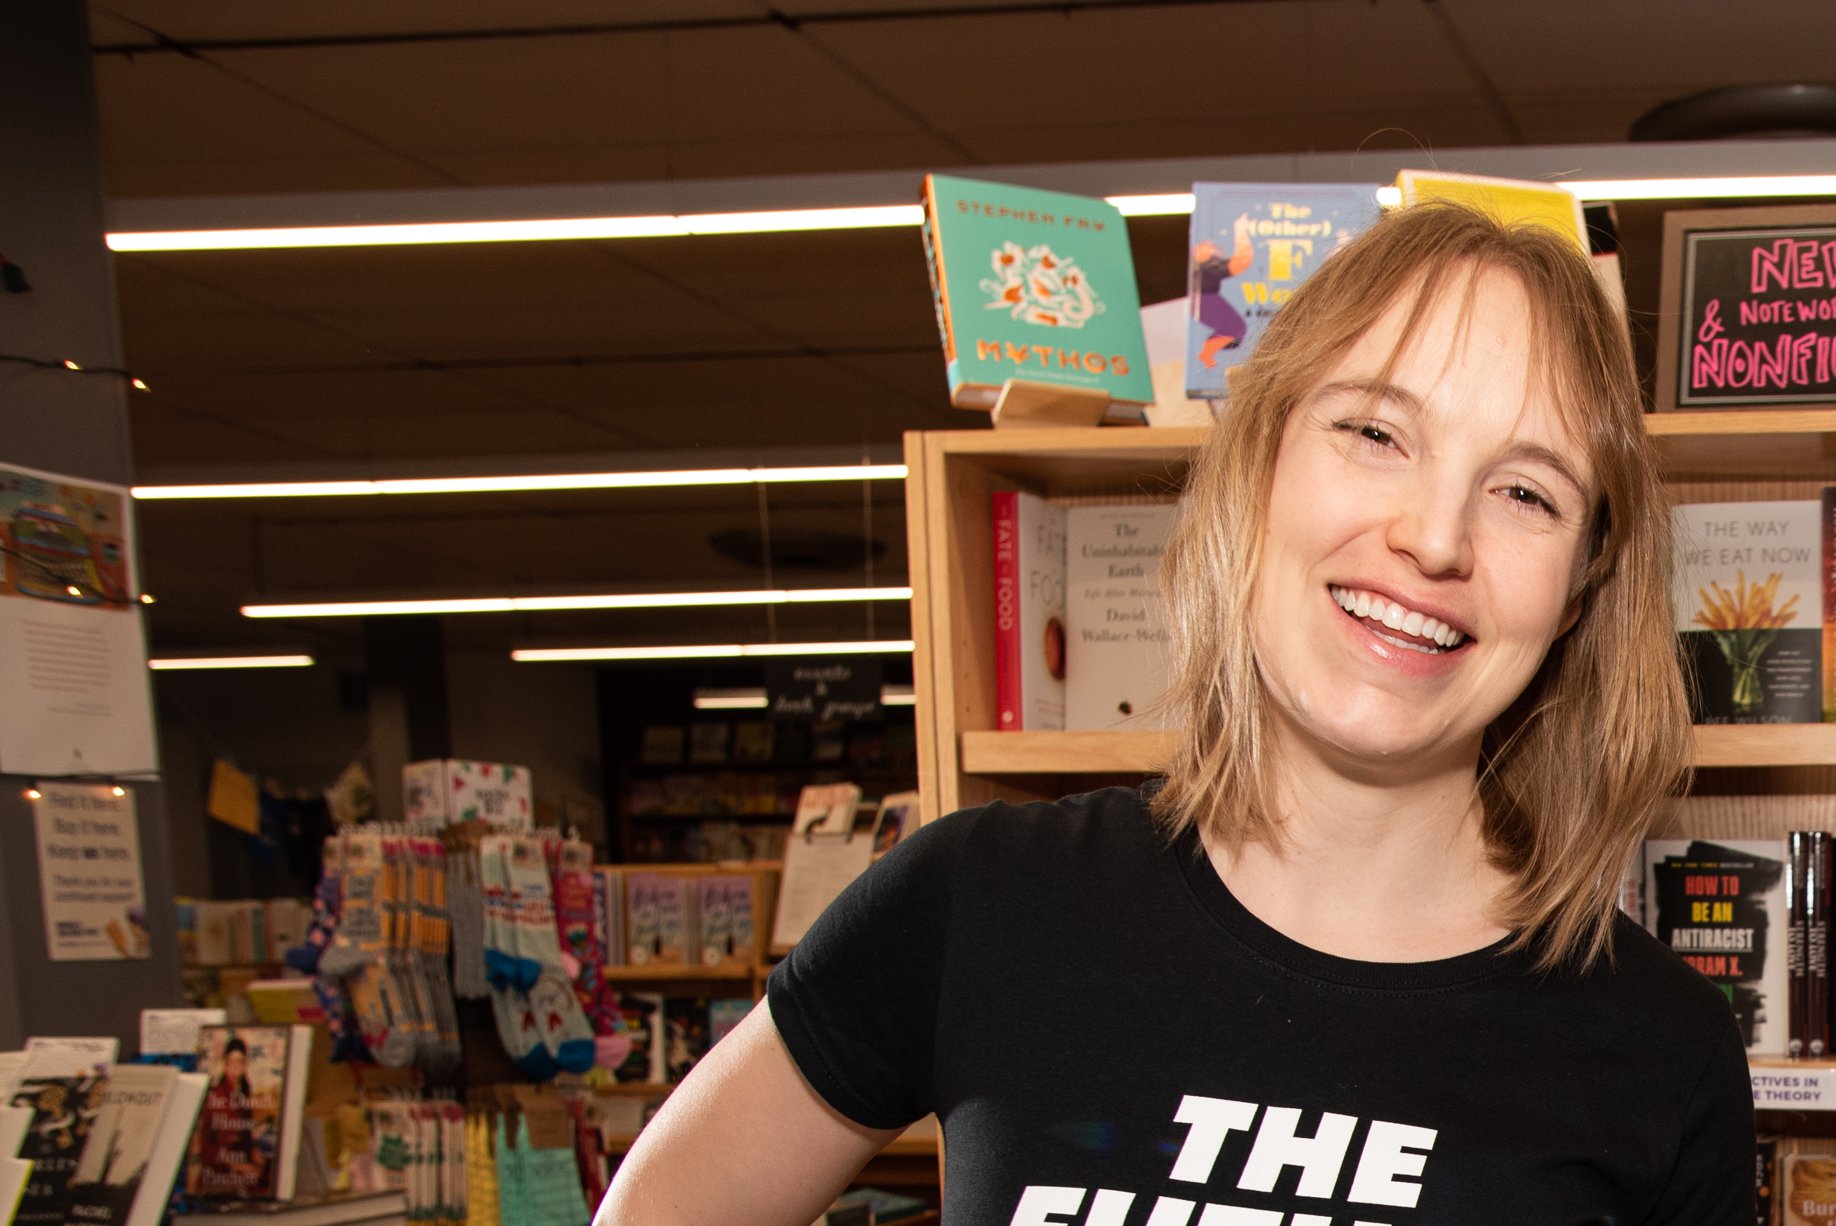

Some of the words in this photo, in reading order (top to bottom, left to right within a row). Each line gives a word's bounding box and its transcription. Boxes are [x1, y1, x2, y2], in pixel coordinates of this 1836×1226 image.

[957, 199, 1054, 224] STEPHEN
[1269, 203, 1312, 219] The
[1698, 300, 1725, 341] &
[976, 338, 1130, 377] MYTHOS
[1114, 523, 1140, 537] The
[1704, 522, 1739, 538] THE
[1747, 521, 1790, 537] WAY
[1719, 548, 1754, 566] EAT
[1762, 547, 1812, 565] NOW
[1108, 564, 1144, 578] Earth
[998, 577, 1013, 631] FOOD
[1106, 609, 1145, 622] David
[1685, 875, 1719, 896] HOW
[1721, 876, 1740, 895] TO
[1691, 902, 1710, 923] BE
[1712, 902, 1733, 922] AN
[1671, 928, 1754, 949] ANTIRACIST
[1803, 1076, 1819, 1088] IN
[1765, 1090, 1821, 1102] THEORY
[1169, 1095, 1438, 1208] THE
